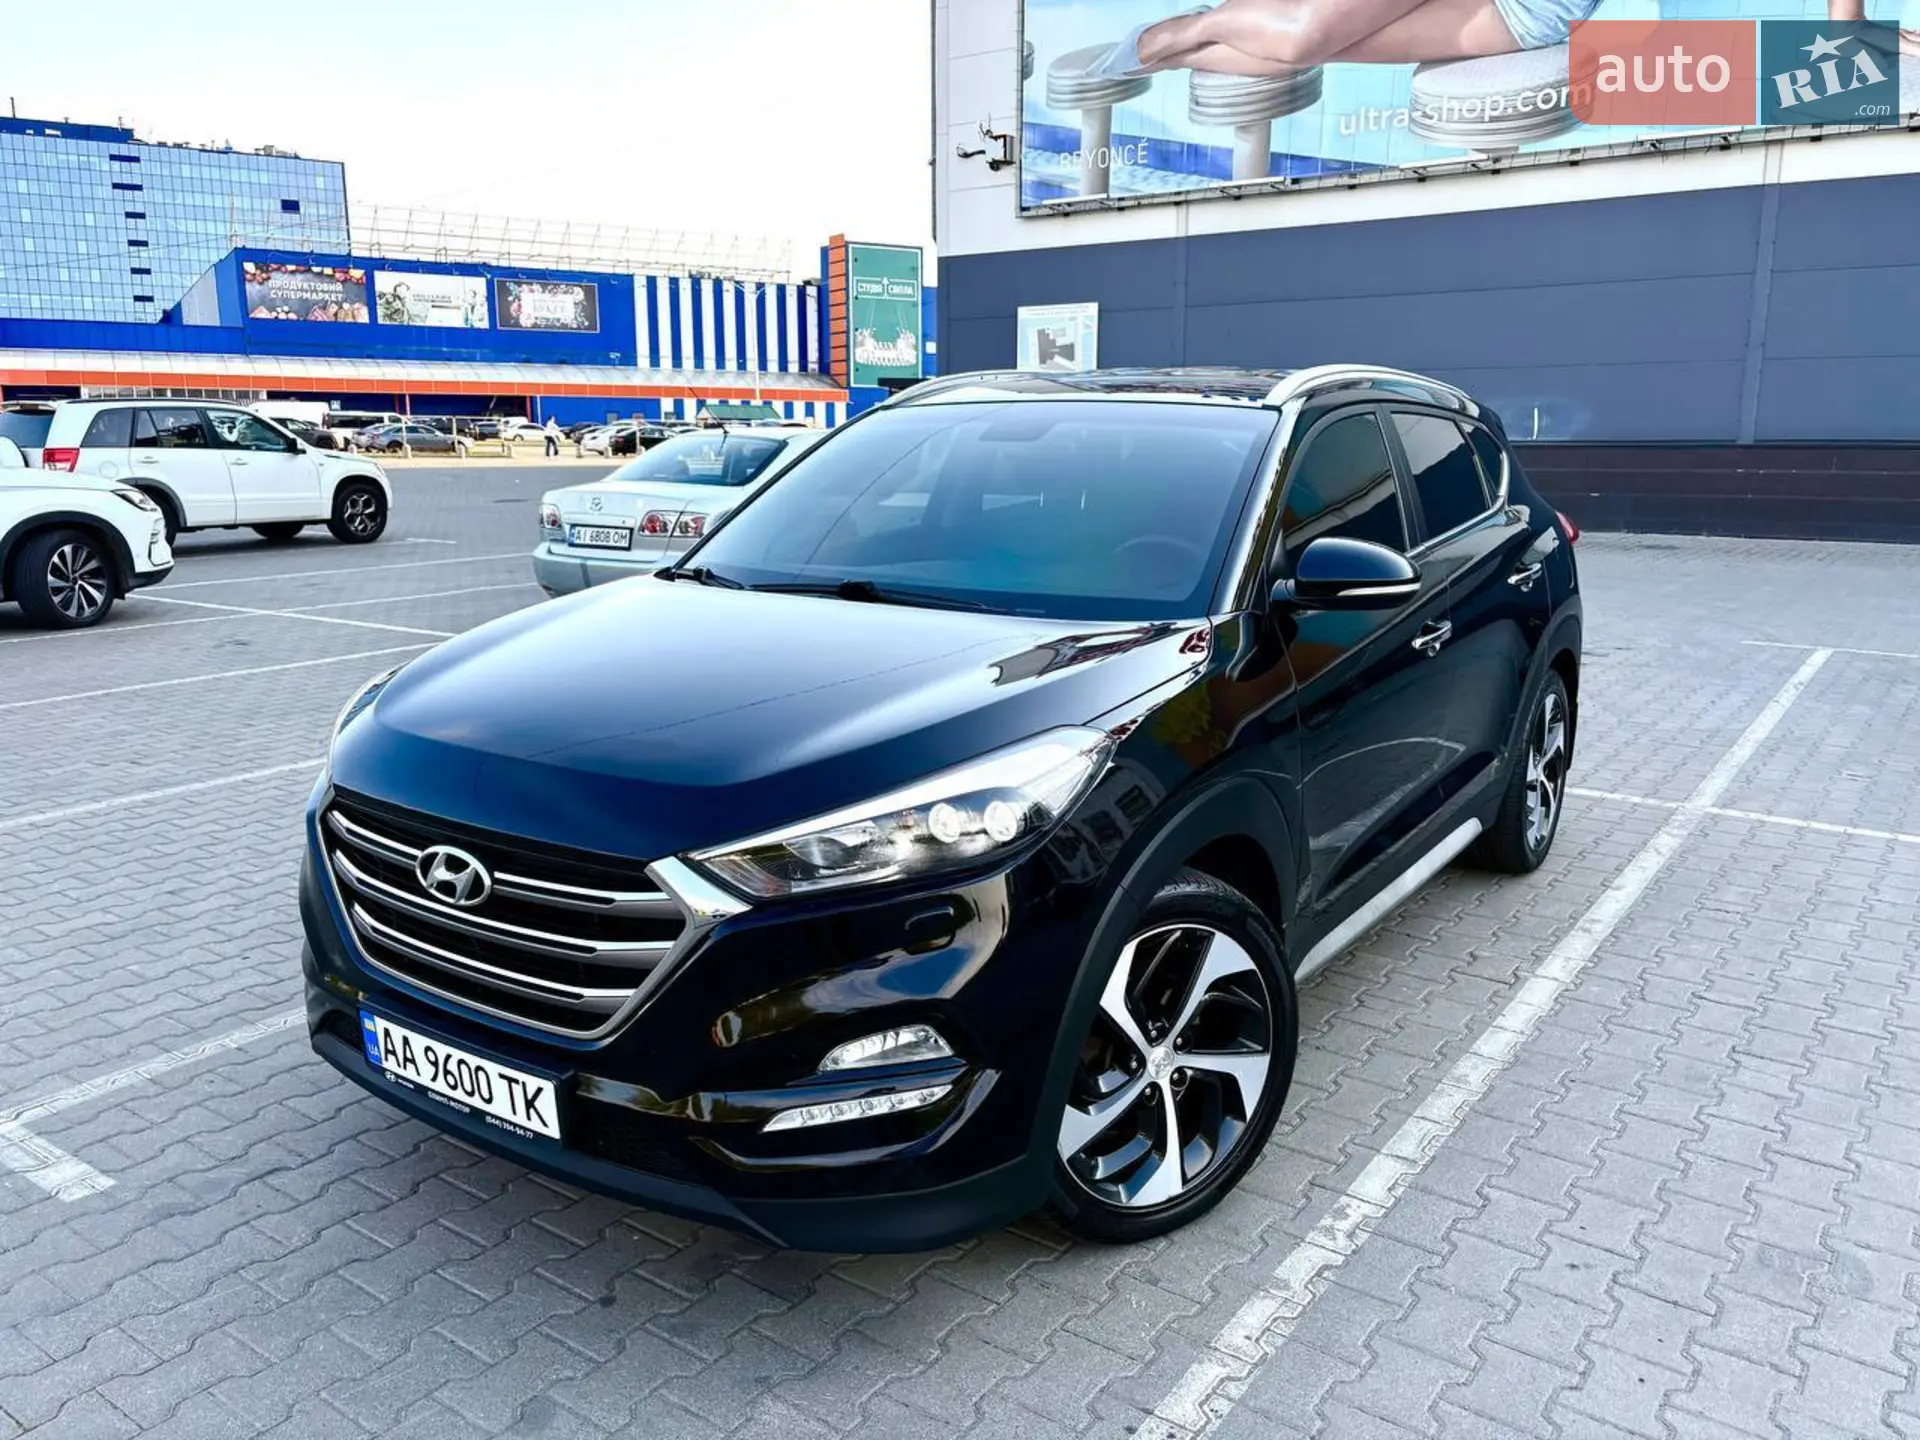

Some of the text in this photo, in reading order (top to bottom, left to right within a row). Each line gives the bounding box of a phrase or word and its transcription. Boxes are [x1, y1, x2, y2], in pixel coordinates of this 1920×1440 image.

[1339, 84, 1592, 136] ultra-shop.com
[1060, 136, 1149, 169] BEYONCÉ
[270, 289, 343, 302] СУПЕРМАРКЕТ
[383, 1026, 421, 1077] AA
[424, 1045, 494, 1105] 9600
[498, 1072, 550, 1129] TK
